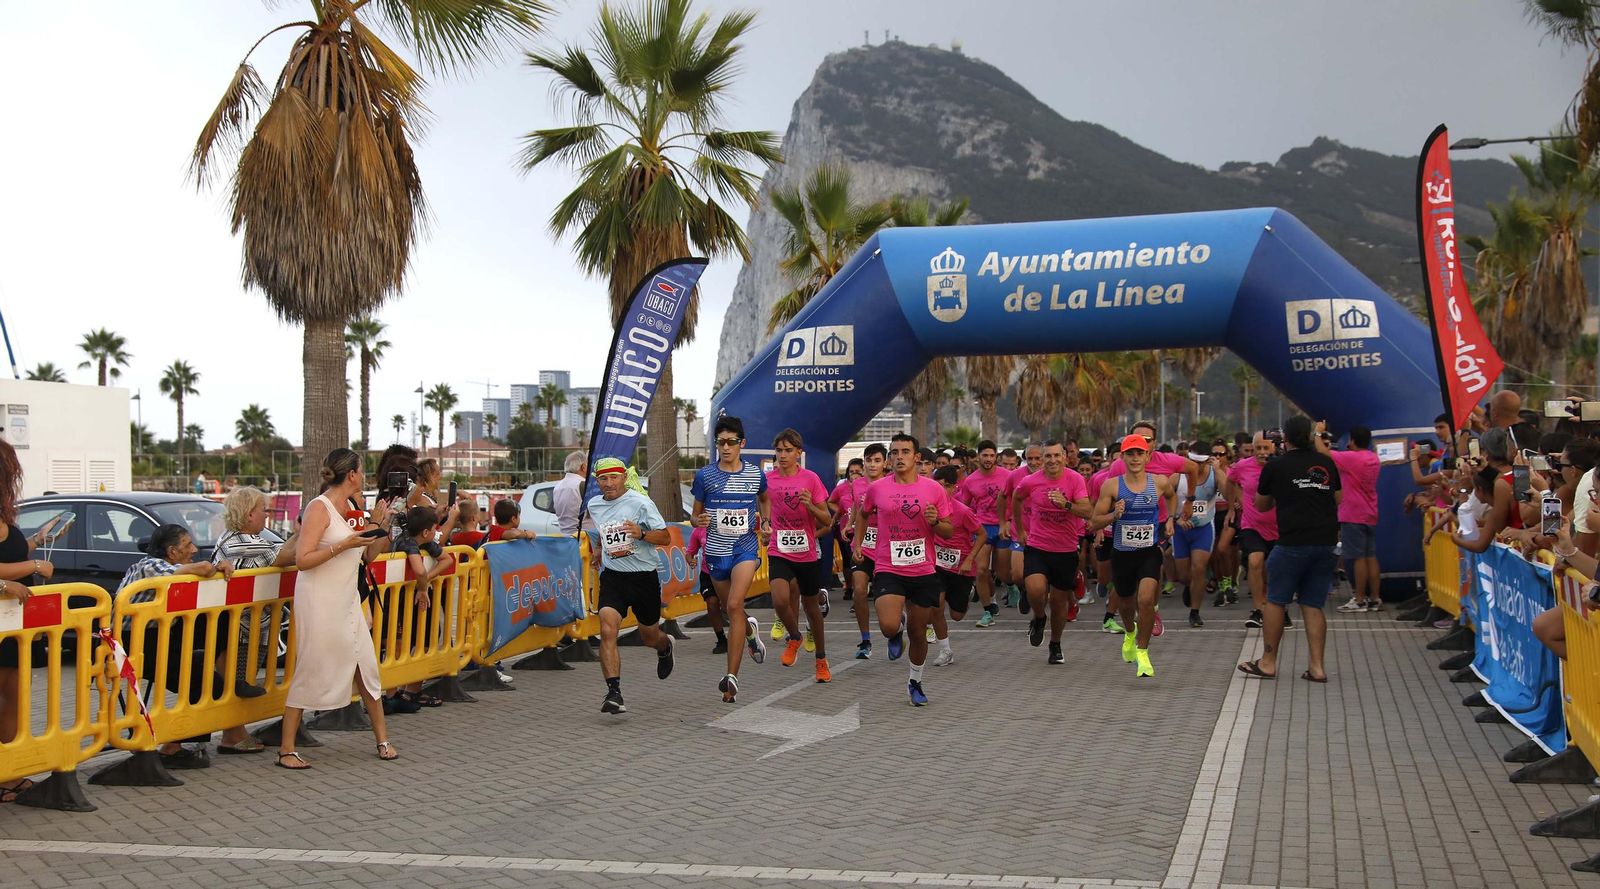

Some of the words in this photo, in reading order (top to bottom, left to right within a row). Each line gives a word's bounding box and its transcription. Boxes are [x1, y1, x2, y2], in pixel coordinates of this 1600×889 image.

[977, 242, 1211, 283] Ayuntamiento
[1003, 285, 1042, 312] de
[1049, 284, 1088, 310] La
[1095, 279, 1186, 308] Línea
[647, 293, 675, 315] UBAGO
[1289, 341, 1349, 354] DELEGACIÓN
[1350, 340, 1364, 349] DE
[1292, 352, 1382, 372] DEPORTES
[605, 339, 625, 409] www.ubagogroup.com
[776, 367, 826, 376] DELEGACIÓN
[828, 367, 840, 375] DE
[604, 326, 669, 438] UBAGO
[774, 379, 855, 393] DEPORTES
[721, 515, 745, 527] 463
[606, 531, 628, 545] 547
[781, 536, 805, 546] 552
[864, 532, 878, 542] 89
[1126, 530, 1150, 541] 542
[895, 545, 921, 558] 766
[937, 551, 956, 563] 639
